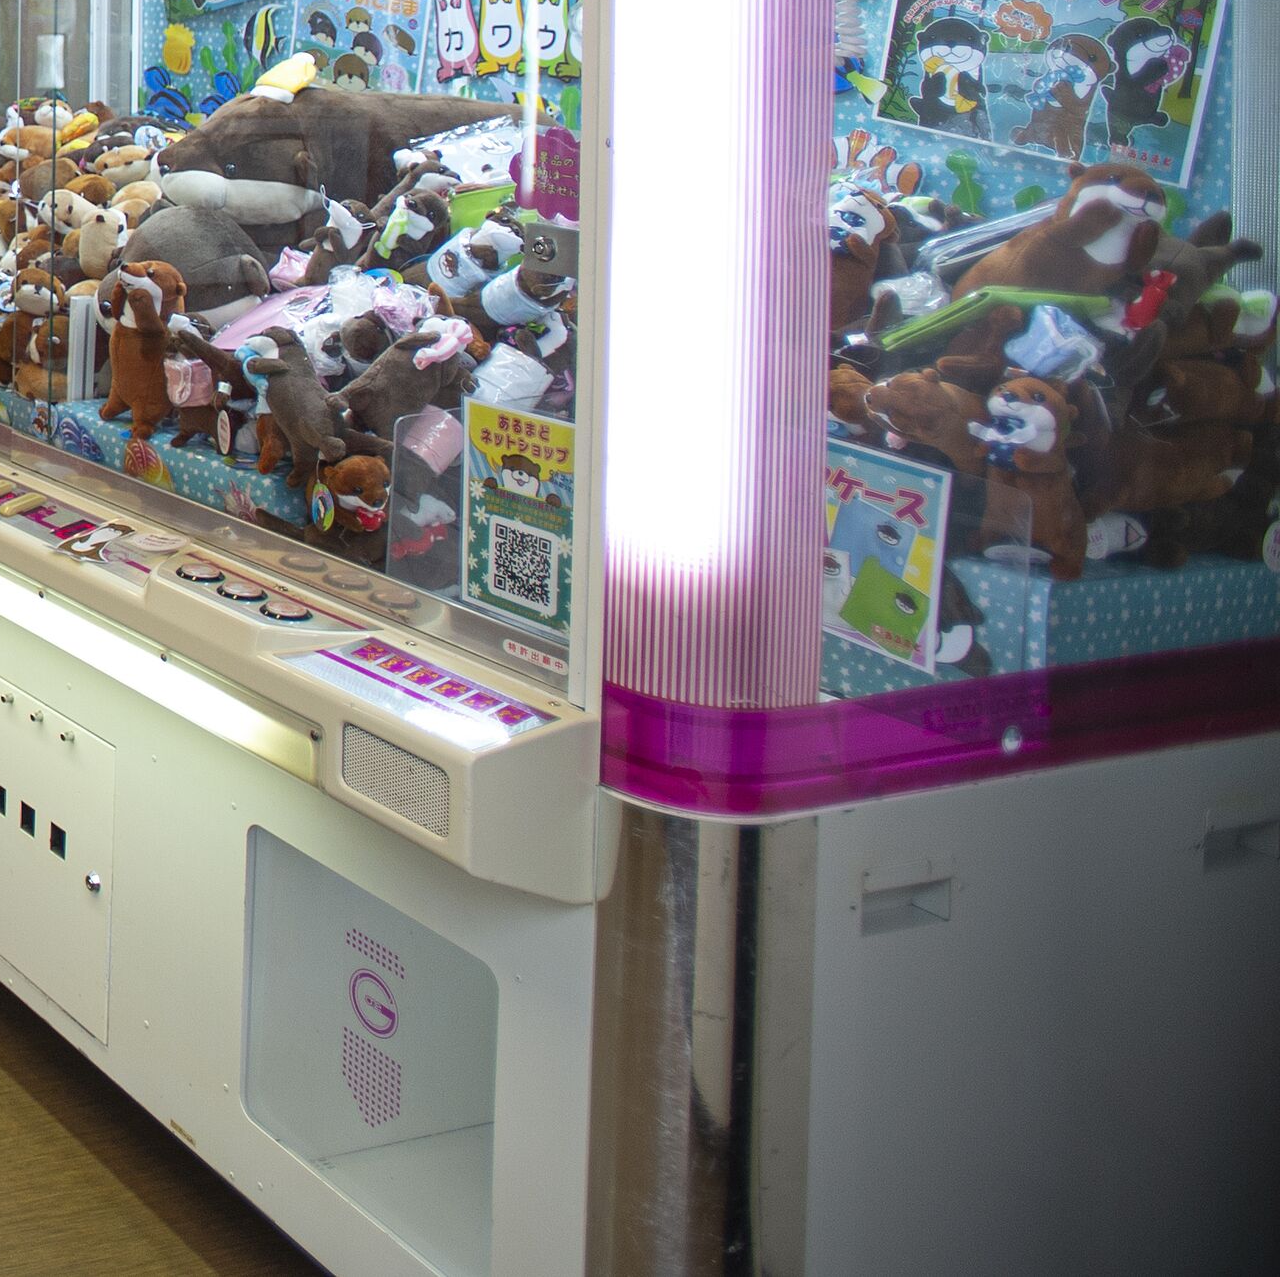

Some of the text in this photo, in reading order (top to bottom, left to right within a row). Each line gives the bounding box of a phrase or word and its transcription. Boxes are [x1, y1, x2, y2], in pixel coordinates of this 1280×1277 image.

[444, 23, 558, 53] カ ワ ウ
[480, 427, 569, 463] ネットショップ
[825, 468, 928, 529] ケース
